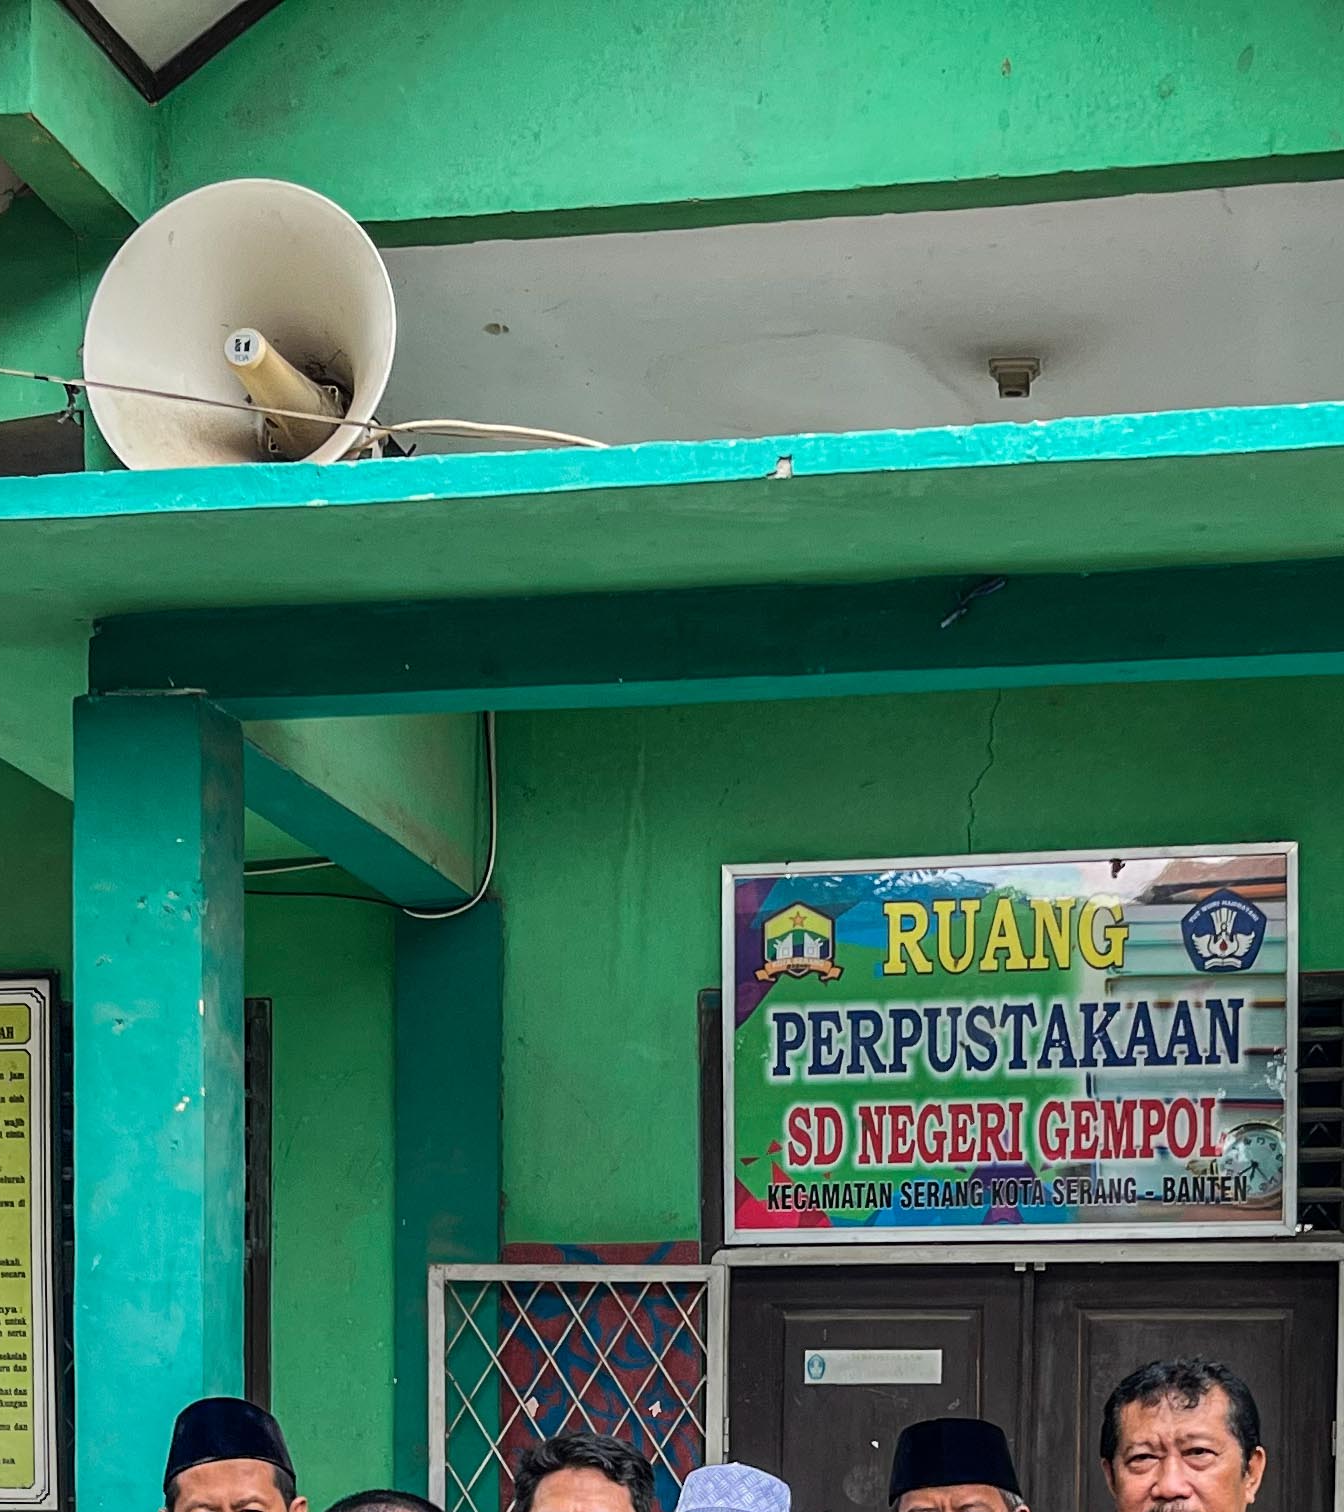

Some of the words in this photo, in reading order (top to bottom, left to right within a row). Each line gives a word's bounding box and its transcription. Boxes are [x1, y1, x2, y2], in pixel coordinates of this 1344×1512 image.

[882, 894, 1129, 975] RUANG
[772, 998, 1245, 1076] PERPUSTAKAAN
[788, 1107, 843, 1166] SD
[858, 1103, 1023, 1164] NEGERI
[1038, 1097, 1227, 1161] GEMPOL
[768, 1183, 892, 1210] KECAMATAN
[900, 1181, 983, 1209] SERANG
[991, 1179, 1045, 1206] KOTA
[1052, 1176, 1137, 1205] SERANG
[1163, 1175, 1247, 1204] BANTEN
